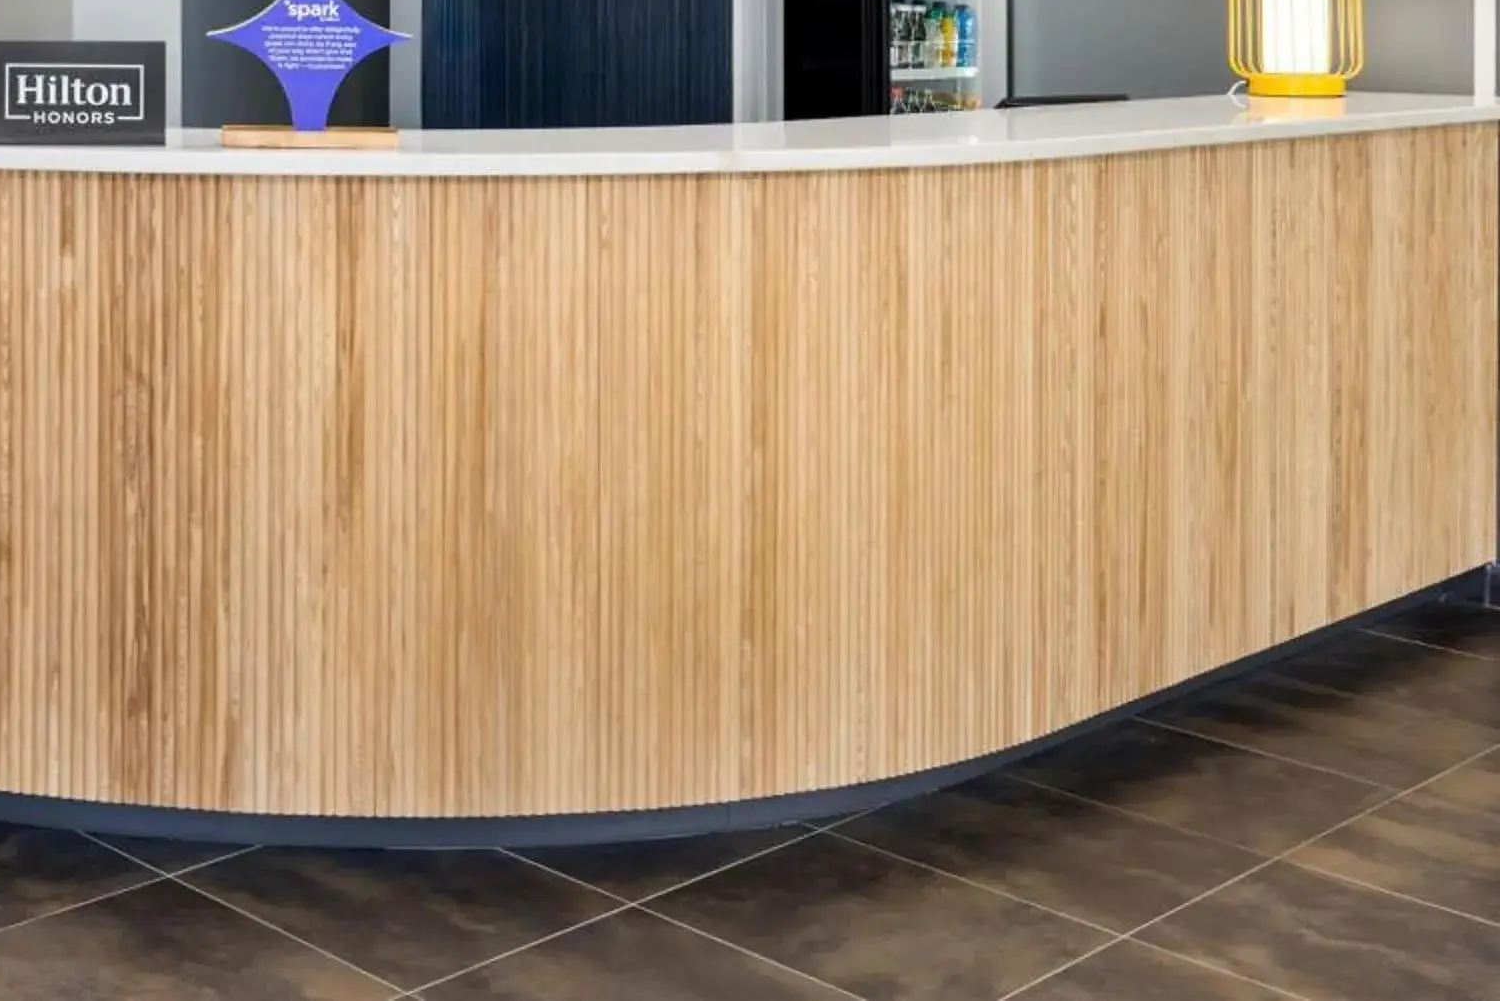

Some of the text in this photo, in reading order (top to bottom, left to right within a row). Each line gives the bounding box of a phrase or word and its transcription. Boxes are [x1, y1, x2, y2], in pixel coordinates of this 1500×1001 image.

[288, 0, 340, 22] spark
[16, 74, 132, 106] Hilton
[32, 111, 116, 124] HONORS
